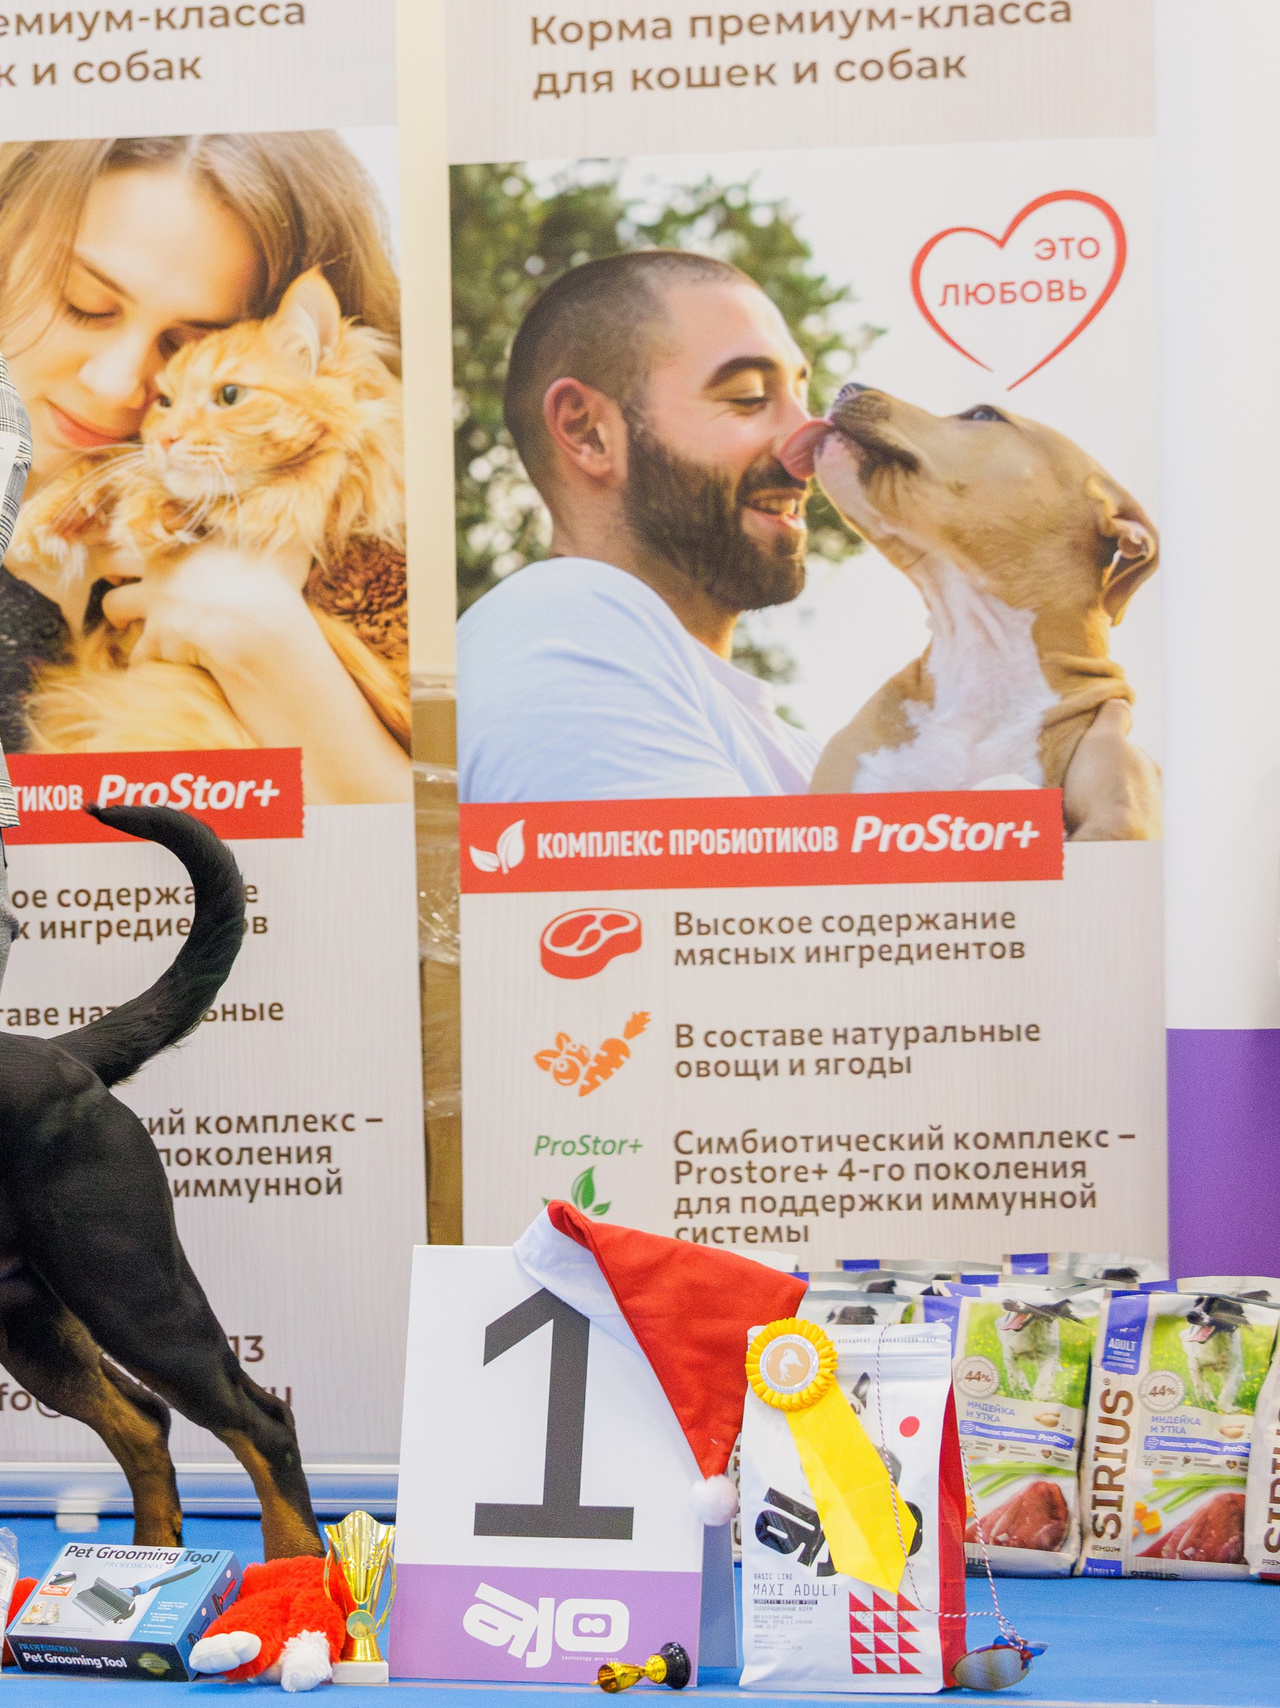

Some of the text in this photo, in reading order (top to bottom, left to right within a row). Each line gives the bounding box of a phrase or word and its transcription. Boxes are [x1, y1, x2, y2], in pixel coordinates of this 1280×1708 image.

[530, 0, 1071, 51] Корма премиум-класса
[33, 62, 56, 85] и
[73, 50, 201, 83] собак
[533, 48, 966, 101] для кошек и собак
[1034, 237, 1100, 260] ЭТО
[939, 279, 1087, 306] ЛЮБОВЬ
[97, 773, 280, 810] ProStor+
[537, 813, 1039, 860] КОМПЛЕКС ПРОБИОТИКОВ ProStor+
[57, 884, 258, 912] содержае
[40, 915, 268, 944] ингредиев
[674, 908, 1016, 937] Высокое содержание
[674, 939, 1026, 969] мясных ингредиентов
[675, 1019, 1041, 1049] В составе натуральные
[675, 1054, 912, 1080] овощи и ягоды
[196, 1112, 356, 1135] комплекс
[534, 1134, 643, 1156] ProStor+
[674, 1124, 944, 1155] Симбиотический
[954, 1128, 1109, 1151] комплекс
[674, 1158, 1087, 1185] Prostore+ 4-го поколения
[173, 1168, 342, 1203] иммунной
[674, 1183, 1097, 1219] для поддержки иммунной
[675, 1222, 809, 1246] системы
[1108, 1337, 1138, 1351] ADULT
[473, 1286, 635, 1540] 1
[967, 1400, 1016, 1416] ИНДЕЙКА
[975, 1411, 1001, 1423] УТКА
[1151, 1414, 1201, 1426] ИНДЕЙКА
[1160, 1425, 1186, 1435] УТКА
[1091, 1388, 1134, 1540] SIRIUS
[64, 1545, 220, 1564] Pet Grooming Tool
[753, 1584, 839, 1596] MAXI ADULT
[22, 1652, 43, 1663] Pet
[45, 1653, 103, 1668] Grooming
[103, 1657, 127, 1668] Tool
